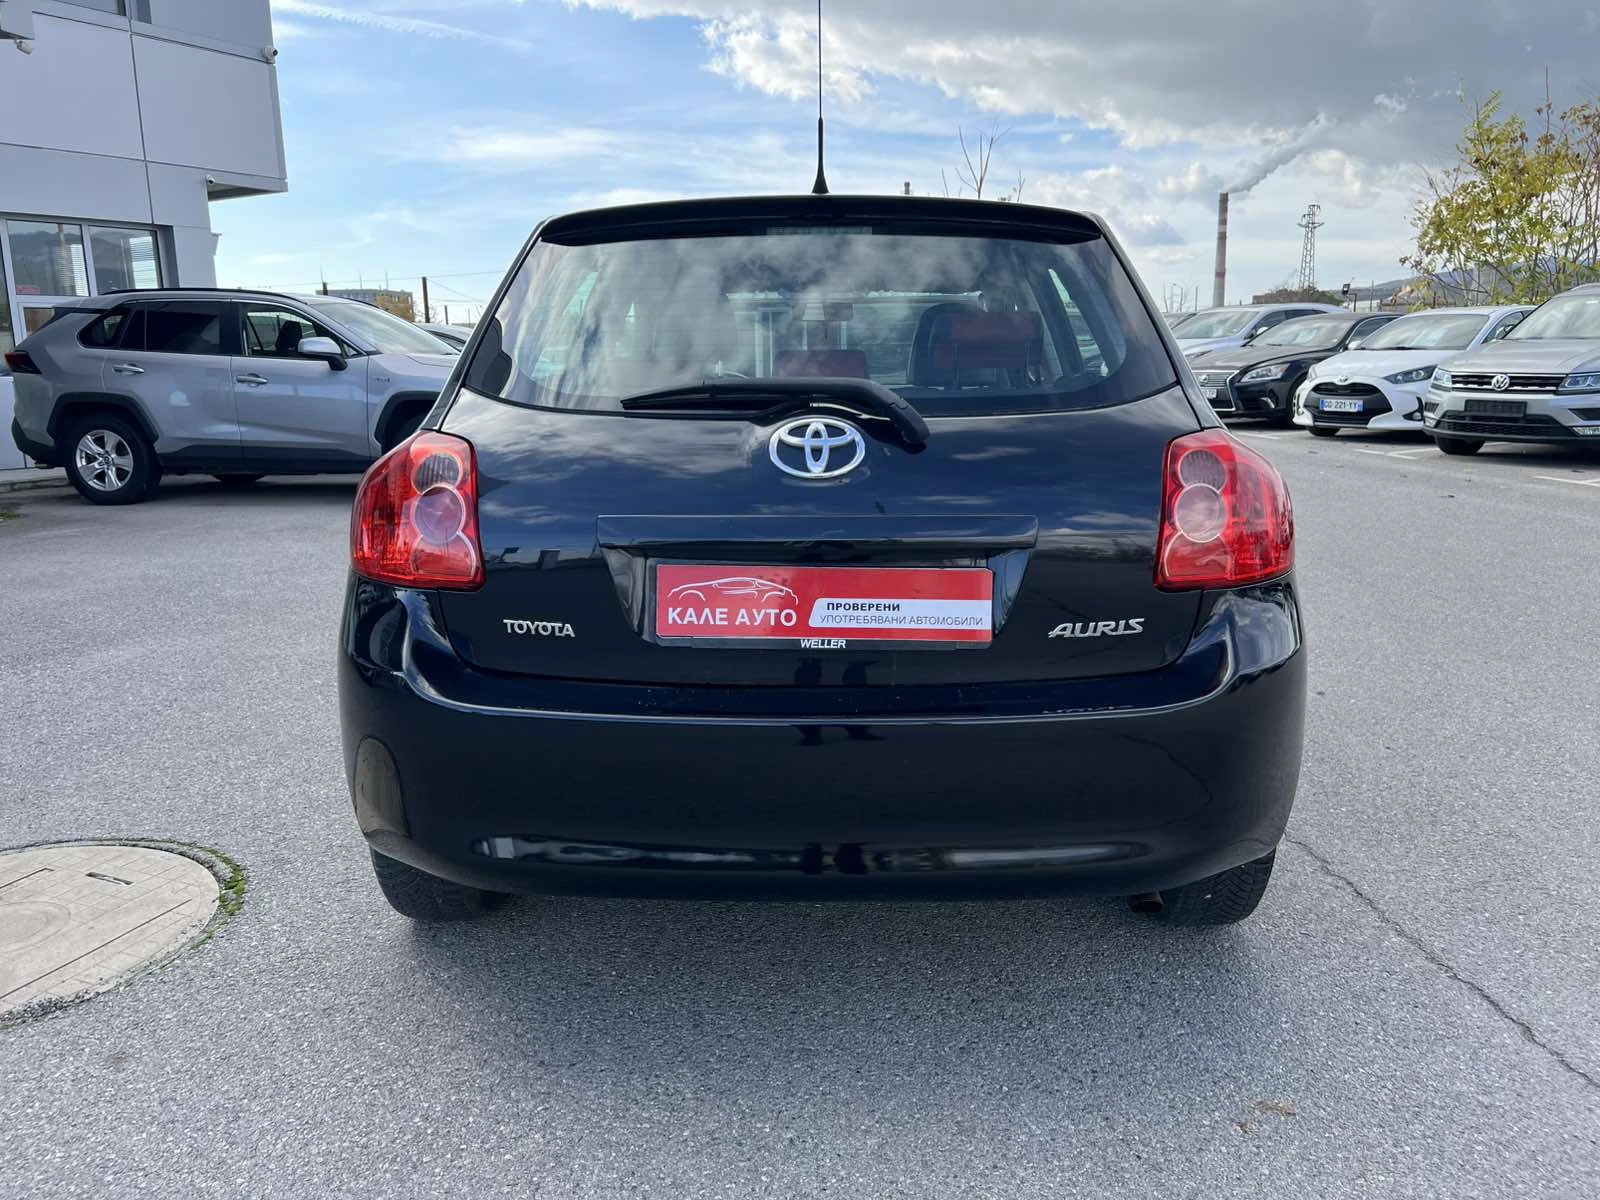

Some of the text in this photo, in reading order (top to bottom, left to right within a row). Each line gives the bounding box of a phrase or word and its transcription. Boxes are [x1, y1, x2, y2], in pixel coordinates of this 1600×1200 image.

[826, 602, 900, 612] ПРОВЕРЕНИ
[667, 607, 797, 627] КАЛЕ АУТО
[820, 615, 984, 626] УПОТРЕБЯВАНИ АВТОМОБИЛИ
[503, 619, 576, 638] TOYOTA
[1047, 618, 1145, 638] AURIS
[800, 638, 847, 649] WELLER
